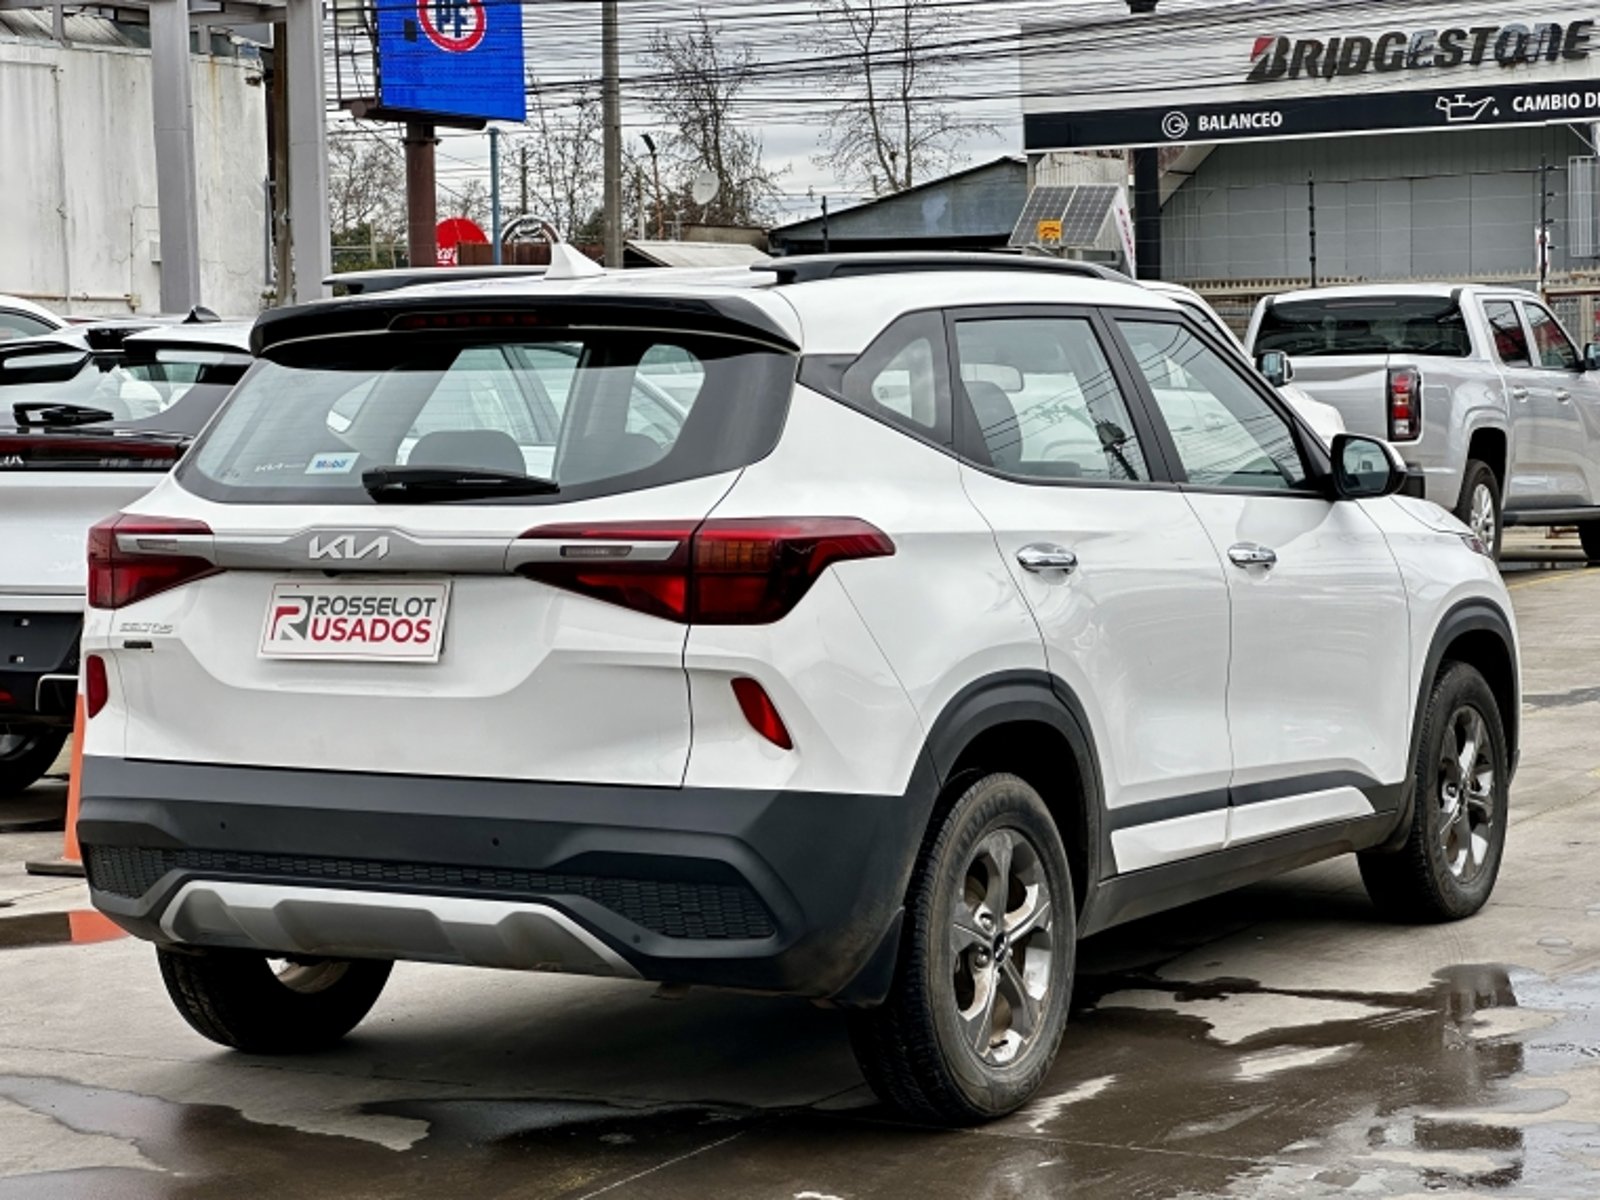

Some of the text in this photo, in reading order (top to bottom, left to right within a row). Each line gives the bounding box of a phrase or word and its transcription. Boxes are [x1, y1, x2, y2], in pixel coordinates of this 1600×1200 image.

[1246, 21, 1594, 80] BRIDGESTONE
[1512, 92, 1580, 112] CAMBIO
[1198, 111, 1283, 131] BALANCEO
[308, 535, 390, 560] KIA
[315, 596, 437, 617] ROSSELOT
[311, 617, 432, 643] USADOS
